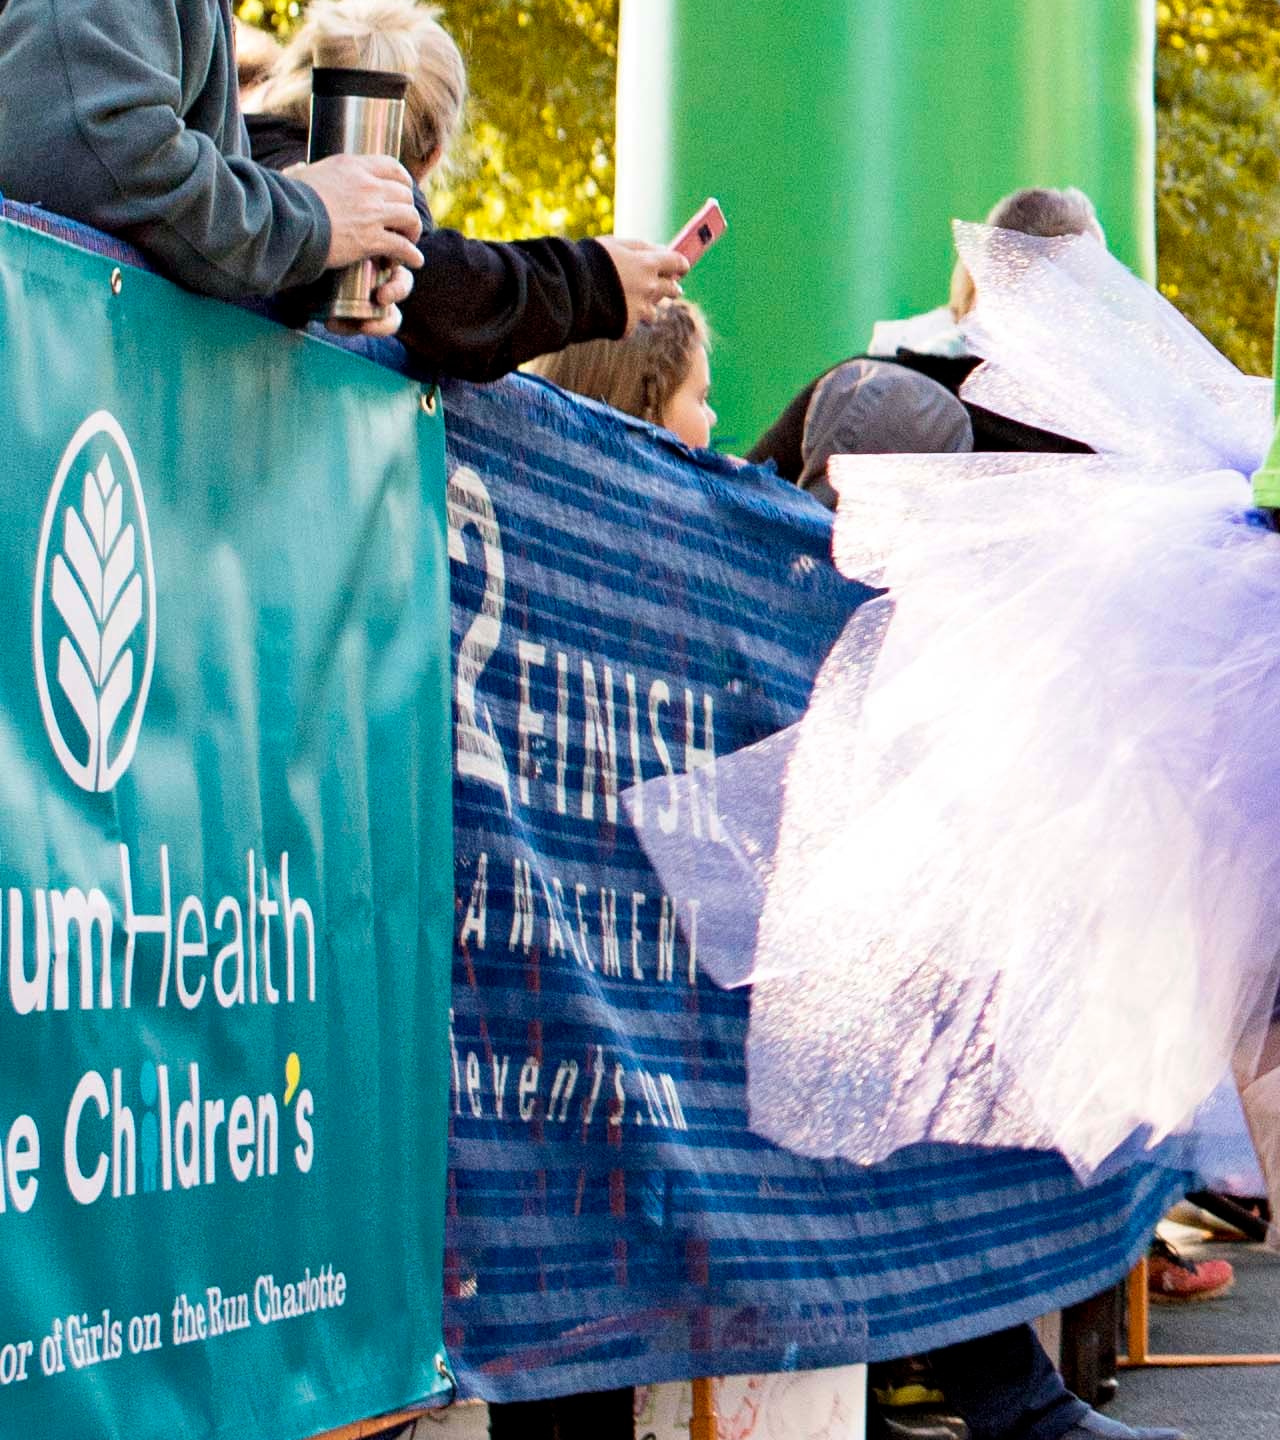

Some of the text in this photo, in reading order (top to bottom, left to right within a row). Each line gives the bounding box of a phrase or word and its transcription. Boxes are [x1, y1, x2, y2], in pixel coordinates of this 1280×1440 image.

[516, 639, 722, 843] FINISH
[0, 843, 316, 1015] umHealth
[0, 1052, 315, 1214] e Children's
[41, 1317, 63, 1377] of
[64, 1309, 122, 1370] Girls
[129, 1311, 162, 1355] on
[171, 1294, 207, 1346] the
[206, 1284, 250, 1336] Run
[254, 1263, 347, 1327] Charlotte
